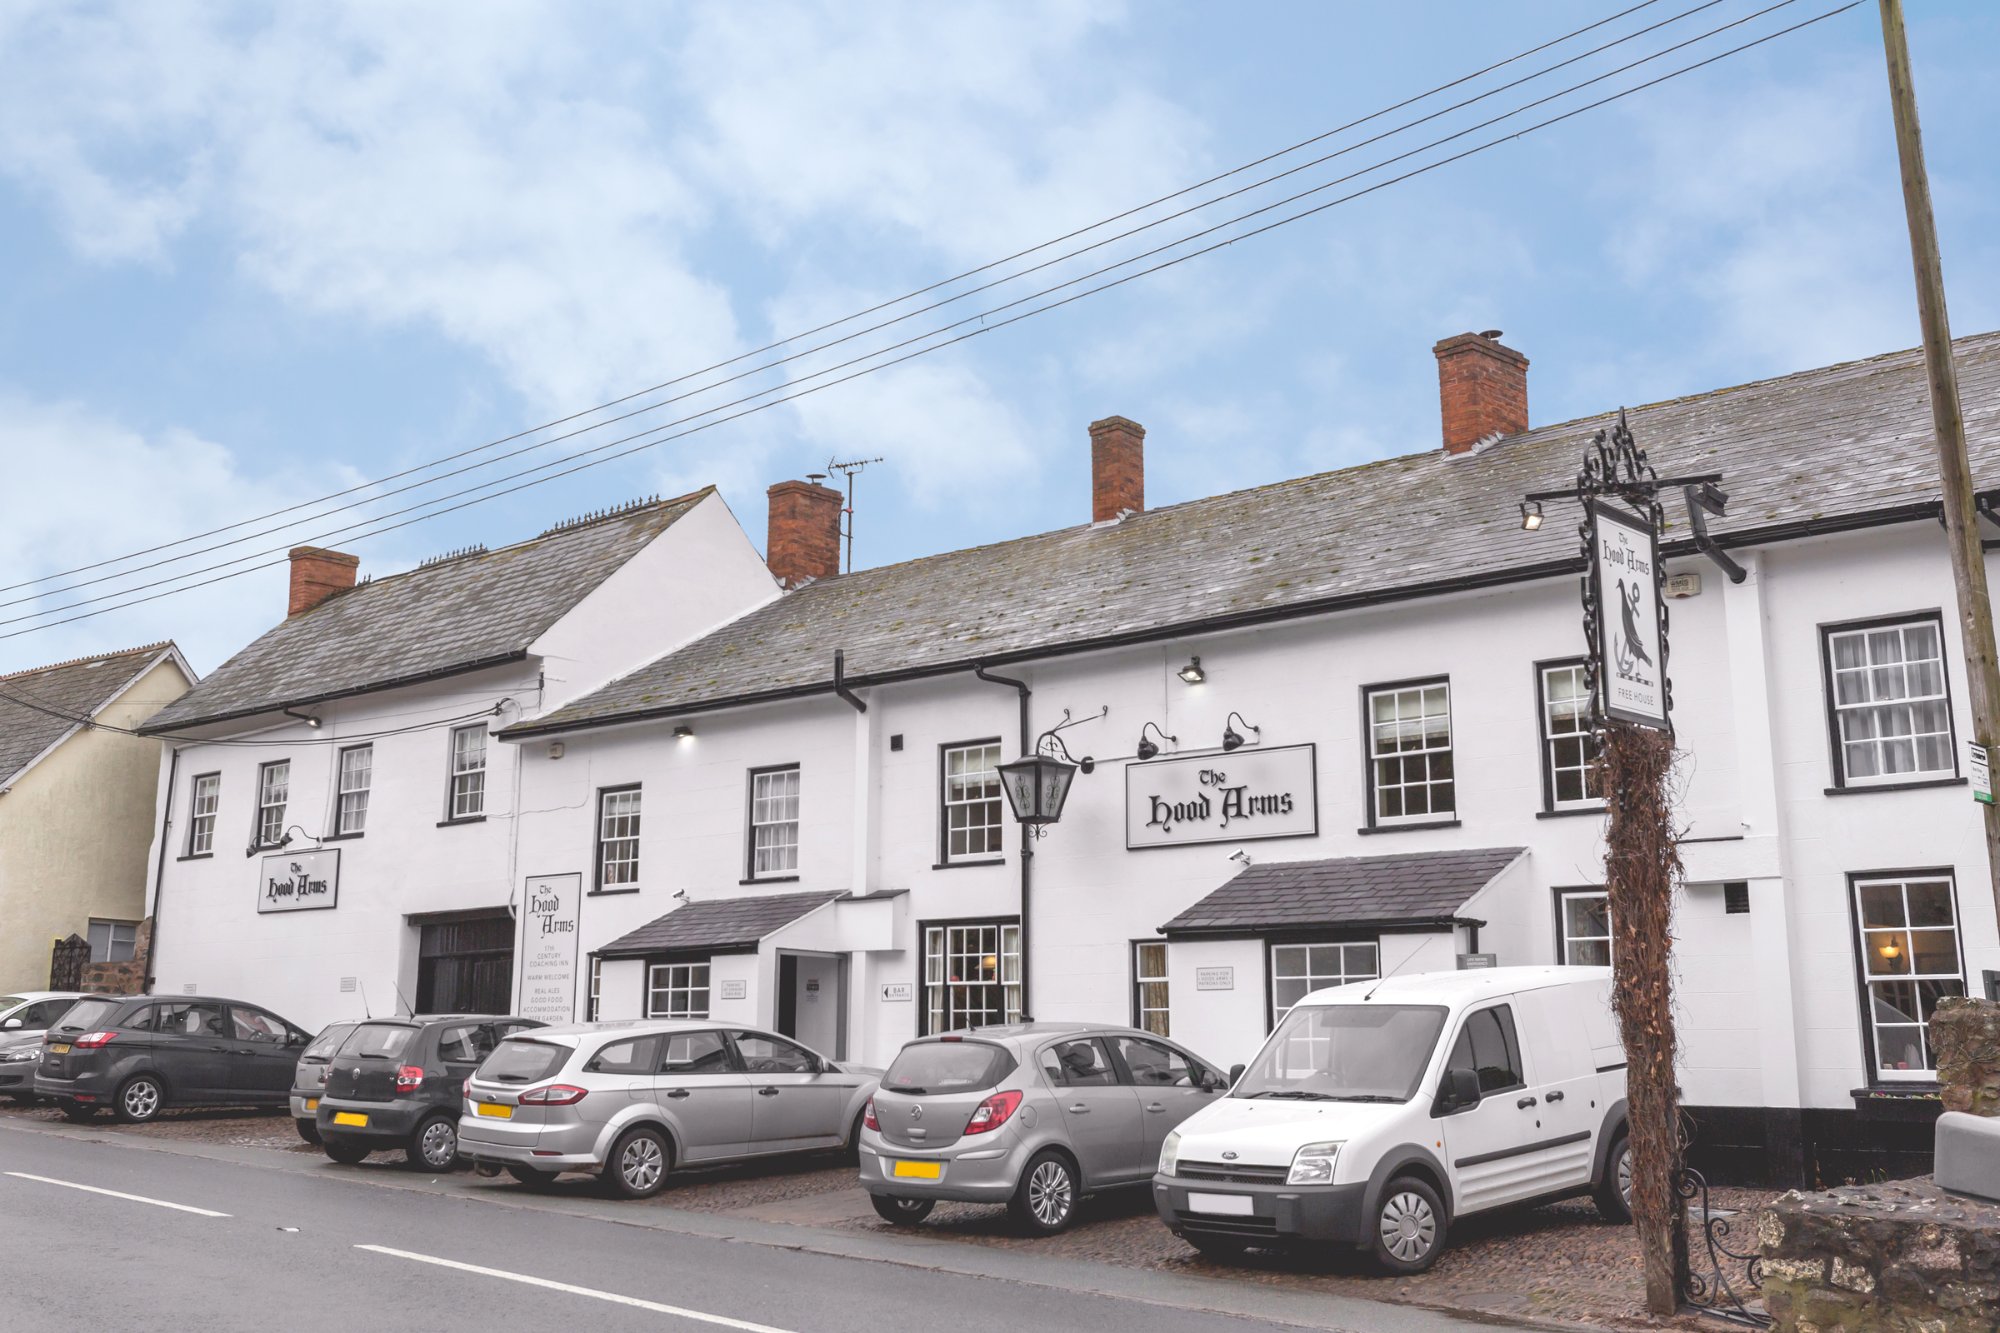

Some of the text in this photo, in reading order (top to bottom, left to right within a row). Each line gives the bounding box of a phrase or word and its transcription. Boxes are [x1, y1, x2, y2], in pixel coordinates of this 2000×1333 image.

[1618, 532, 1628, 545] The
[1603, 540, 1649, 575] Hood Arms
[1618, 687, 1654, 706] FREE HOUSE
[1199, 769, 1227, 787] The
[1146, 785, 1293, 832] Hood Arms
[290, 862, 302, 873] The
[266, 873, 327, 903] Hood Arms
[540, 885, 551, 895] The
[529, 894, 559, 918] Hood
[540, 914, 574, 939] Arms
[529, 960, 558, 968] COACHING
[537, 952, 561, 960] CENTURY
[543, 973, 570, 981] WELCOME
